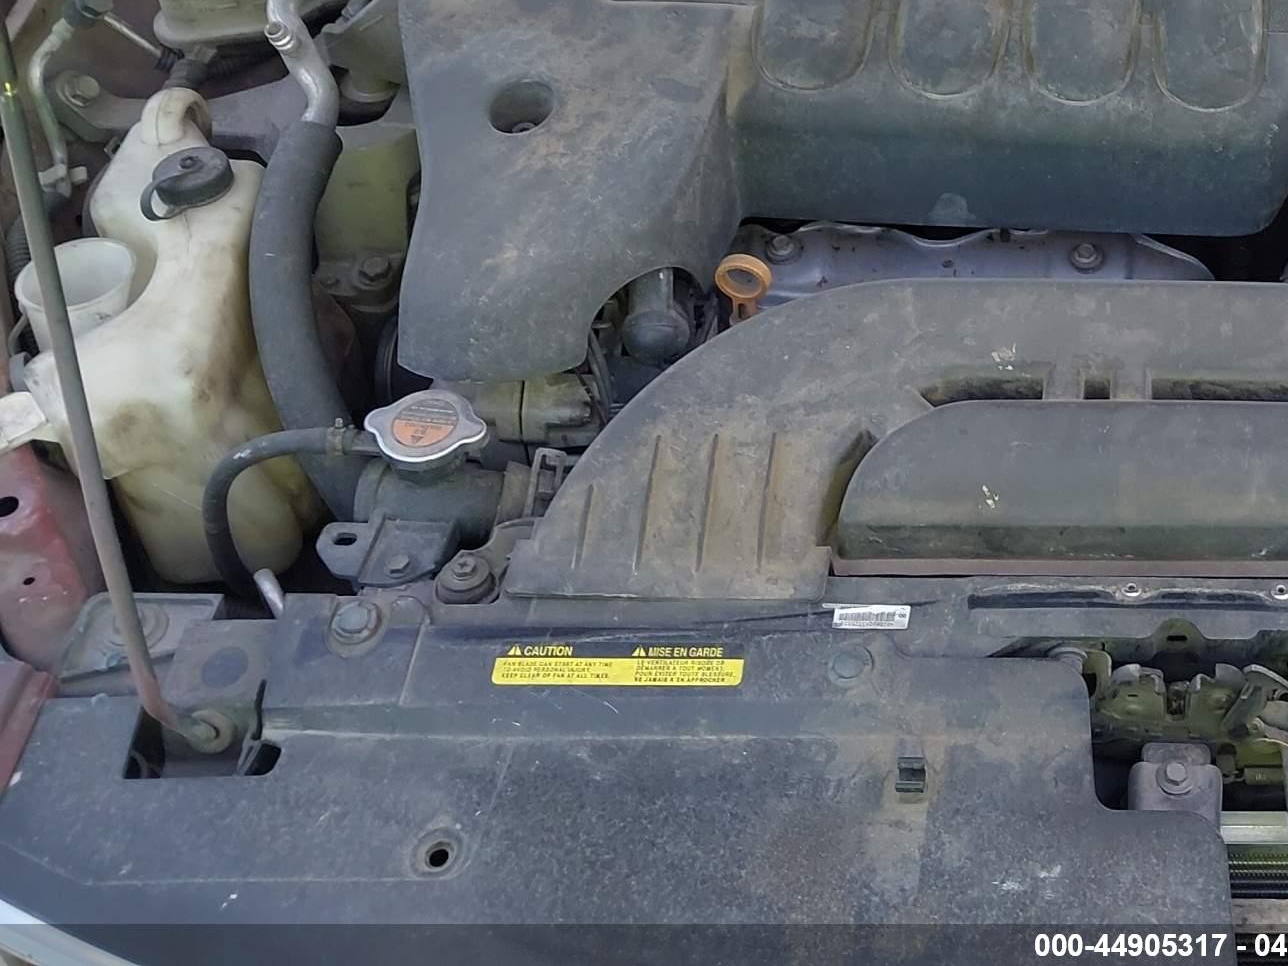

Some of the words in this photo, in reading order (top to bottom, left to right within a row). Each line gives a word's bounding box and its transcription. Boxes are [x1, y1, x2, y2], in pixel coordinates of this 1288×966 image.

[523, 645, 574, 657] CAUTION
[648, 646, 673, 657] MISE
[673, 647, 688, 657] EN
[688, 647, 724, 658] GARDE
